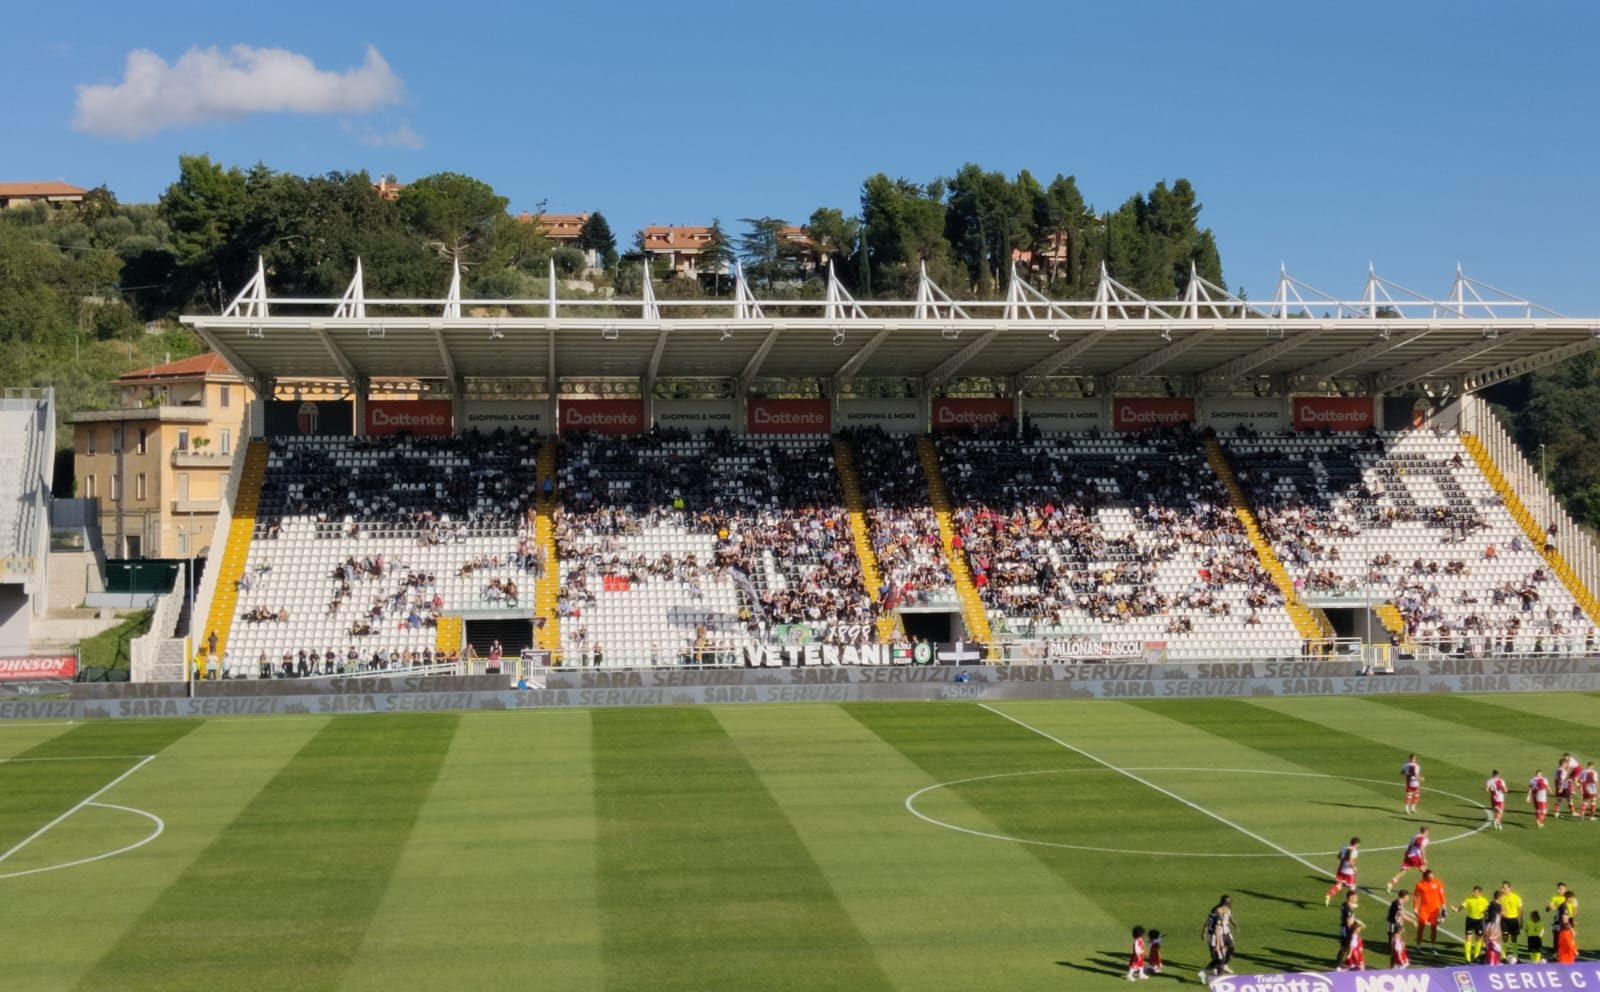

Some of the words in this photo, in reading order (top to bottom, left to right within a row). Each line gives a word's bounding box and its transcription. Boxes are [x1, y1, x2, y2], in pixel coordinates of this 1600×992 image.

[372, 408, 445, 426] Battente
[468, 413, 508, 422] SHOPPING
[520, 413, 541, 422] MORE
[566, 408, 637, 425] Battente
[754, 407, 824, 424] Battente
[939, 406, 1003, 423] Battent
[1300, 405, 1367, 422] Battente
[745, 645, 890, 666] VETERANI
[1109, 640, 1143, 656] ASCOLI
[790, 668, 850, 684] SARA
[858, 667, 949, 683] SERVIZI
[996, 666, 1054, 682] SARA
[1064, 665, 1152, 681] SERVIZI
[1197, 663, 1255, 678] SARA
[1429, 660, 1484, 675] SARA
[1492, 659, 1578, 674] SERVIZI
[329, 678, 393, 694] SARA
[581, 672, 643, 688] SARA
[652, 670, 744, 686] SERVIZI
[1282, 679, 1335, 694] SARA
[1342, 678, 1421, 693] SERVIZI
[1460, 677, 1510, 691] SARA
[514, 690, 570, 706] SARA
[579, 689, 664, 705] SERVIZI
[703, 687, 757, 702] SARA
[767, 686, 850, 701] SERVIZI
[1103, 682, 1155, 697] SARA
[1163, 681, 1244, 695] SERVIZI
[119, 701, 179, 716] SARA
[187, 699, 276, 715] SERVIZI
[318, 696, 377, 712] SARA
[386, 694, 473, 710] SERVIZI
[1355, 973, 1430, 992] NOW
[1488, 971, 1562, 990] SERIE
[1570, 971, 1587, 988] C
